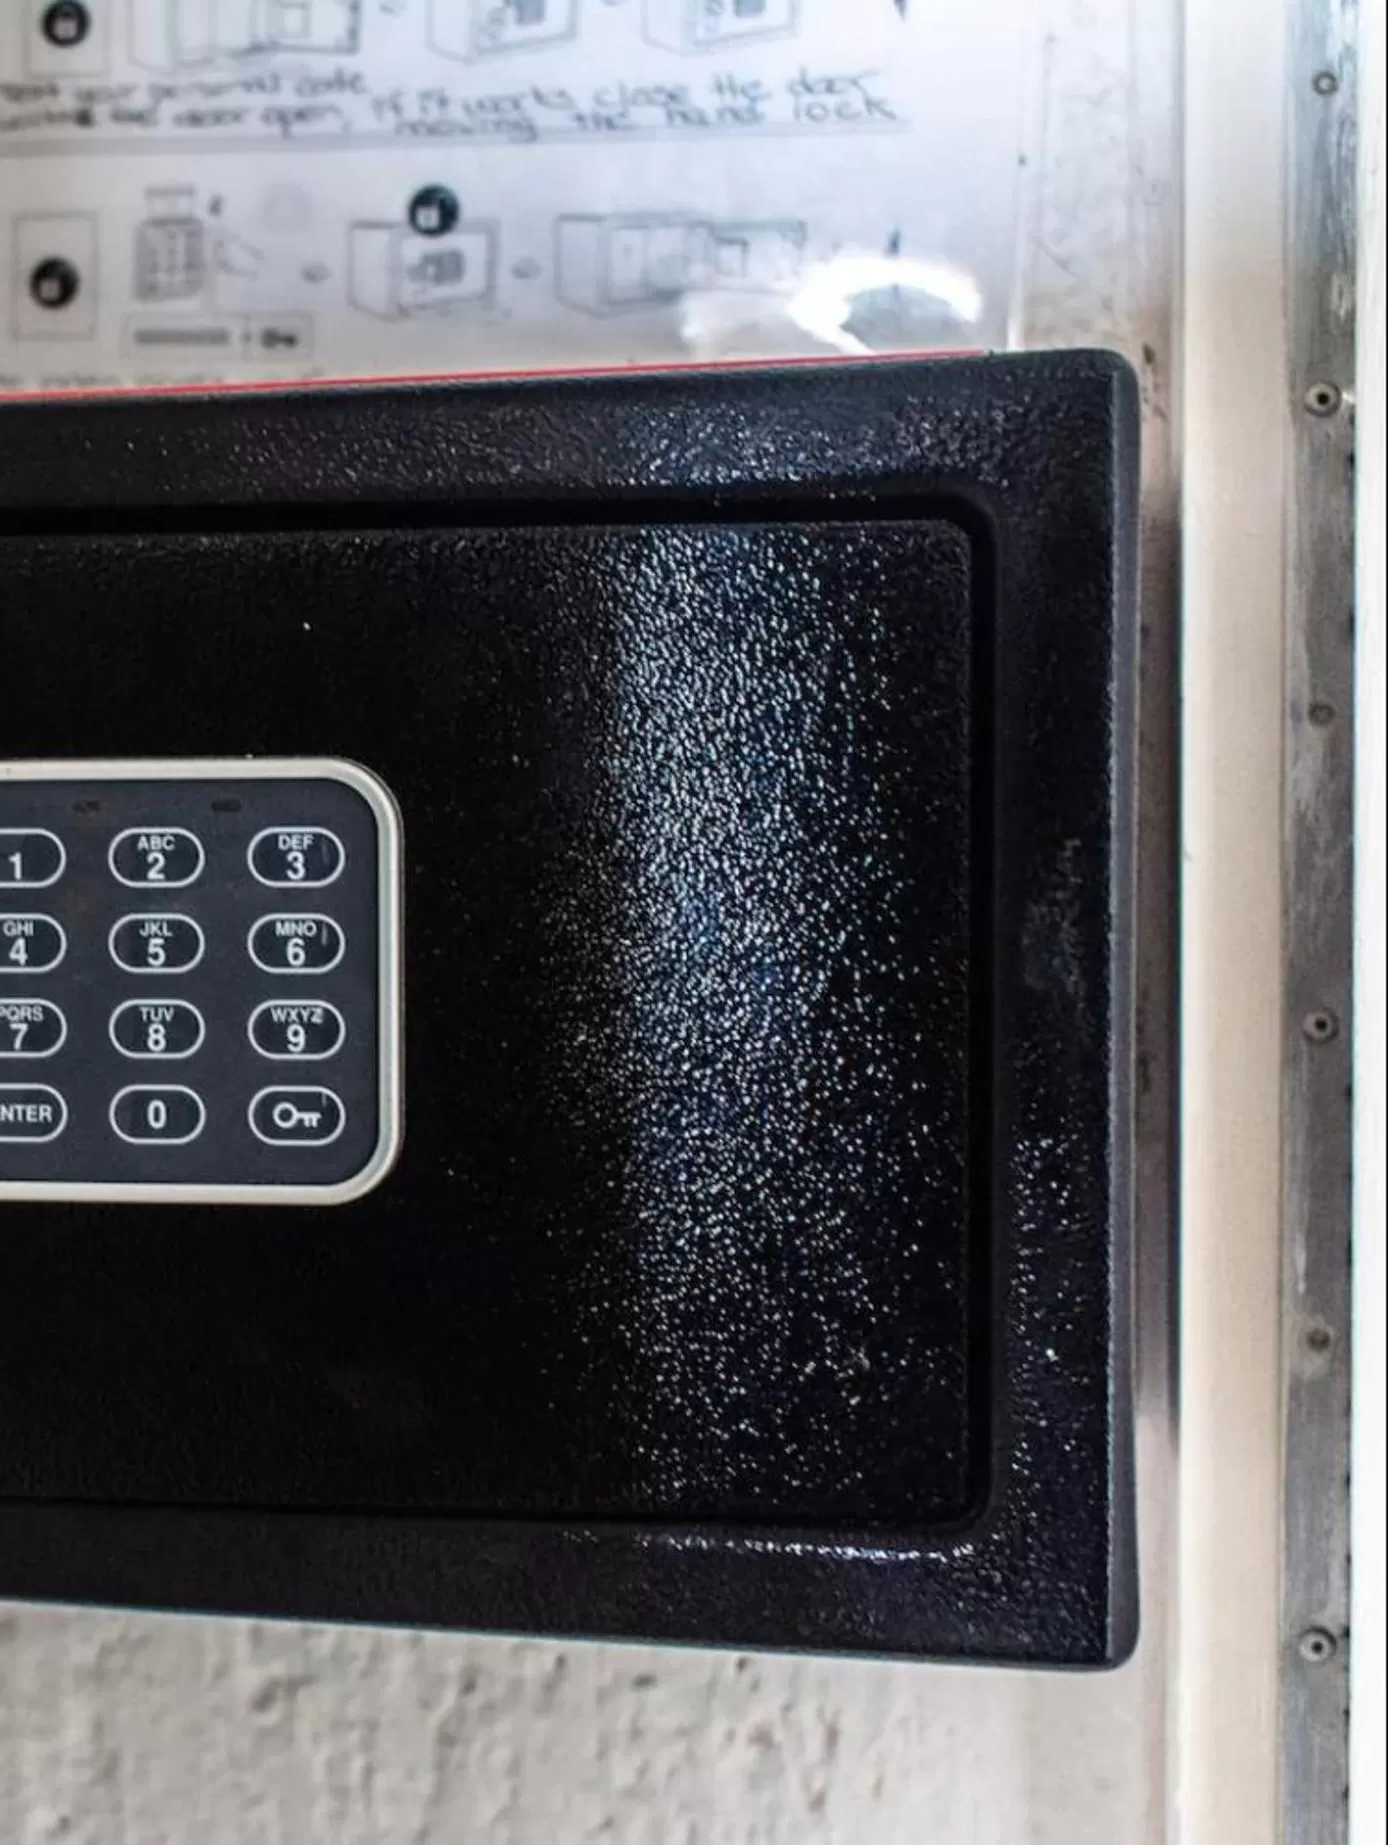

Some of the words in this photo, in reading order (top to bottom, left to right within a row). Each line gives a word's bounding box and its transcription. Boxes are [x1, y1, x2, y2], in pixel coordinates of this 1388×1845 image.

[710, 71, 772, 101] the
[793, 96, 897, 123] lock
[137, 834, 175, 850] ABC
[278, 834, 314, 851] DEF
[9, 852, 22, 880] 1
[146, 851, 166, 880] 2
[286, 851, 306, 881] 3
[2, 920, 34, 937] GHI
[139, 921, 173, 937] JKL
[275, 920, 317, 937] MNO
[8, 937, 28, 966] 4
[147, 937, 166, 967] 5
[286, 937, 306, 967] 6
[139, 1006, 174, 1022] TUV
[269, 1006, 324, 1024] WXYZ
[9, 1022, 29, 1051] 7
[146, 1023, 167, 1052] 8
[286, 1024, 306, 1053] 9
[147, 1099, 167, 1130] 0
